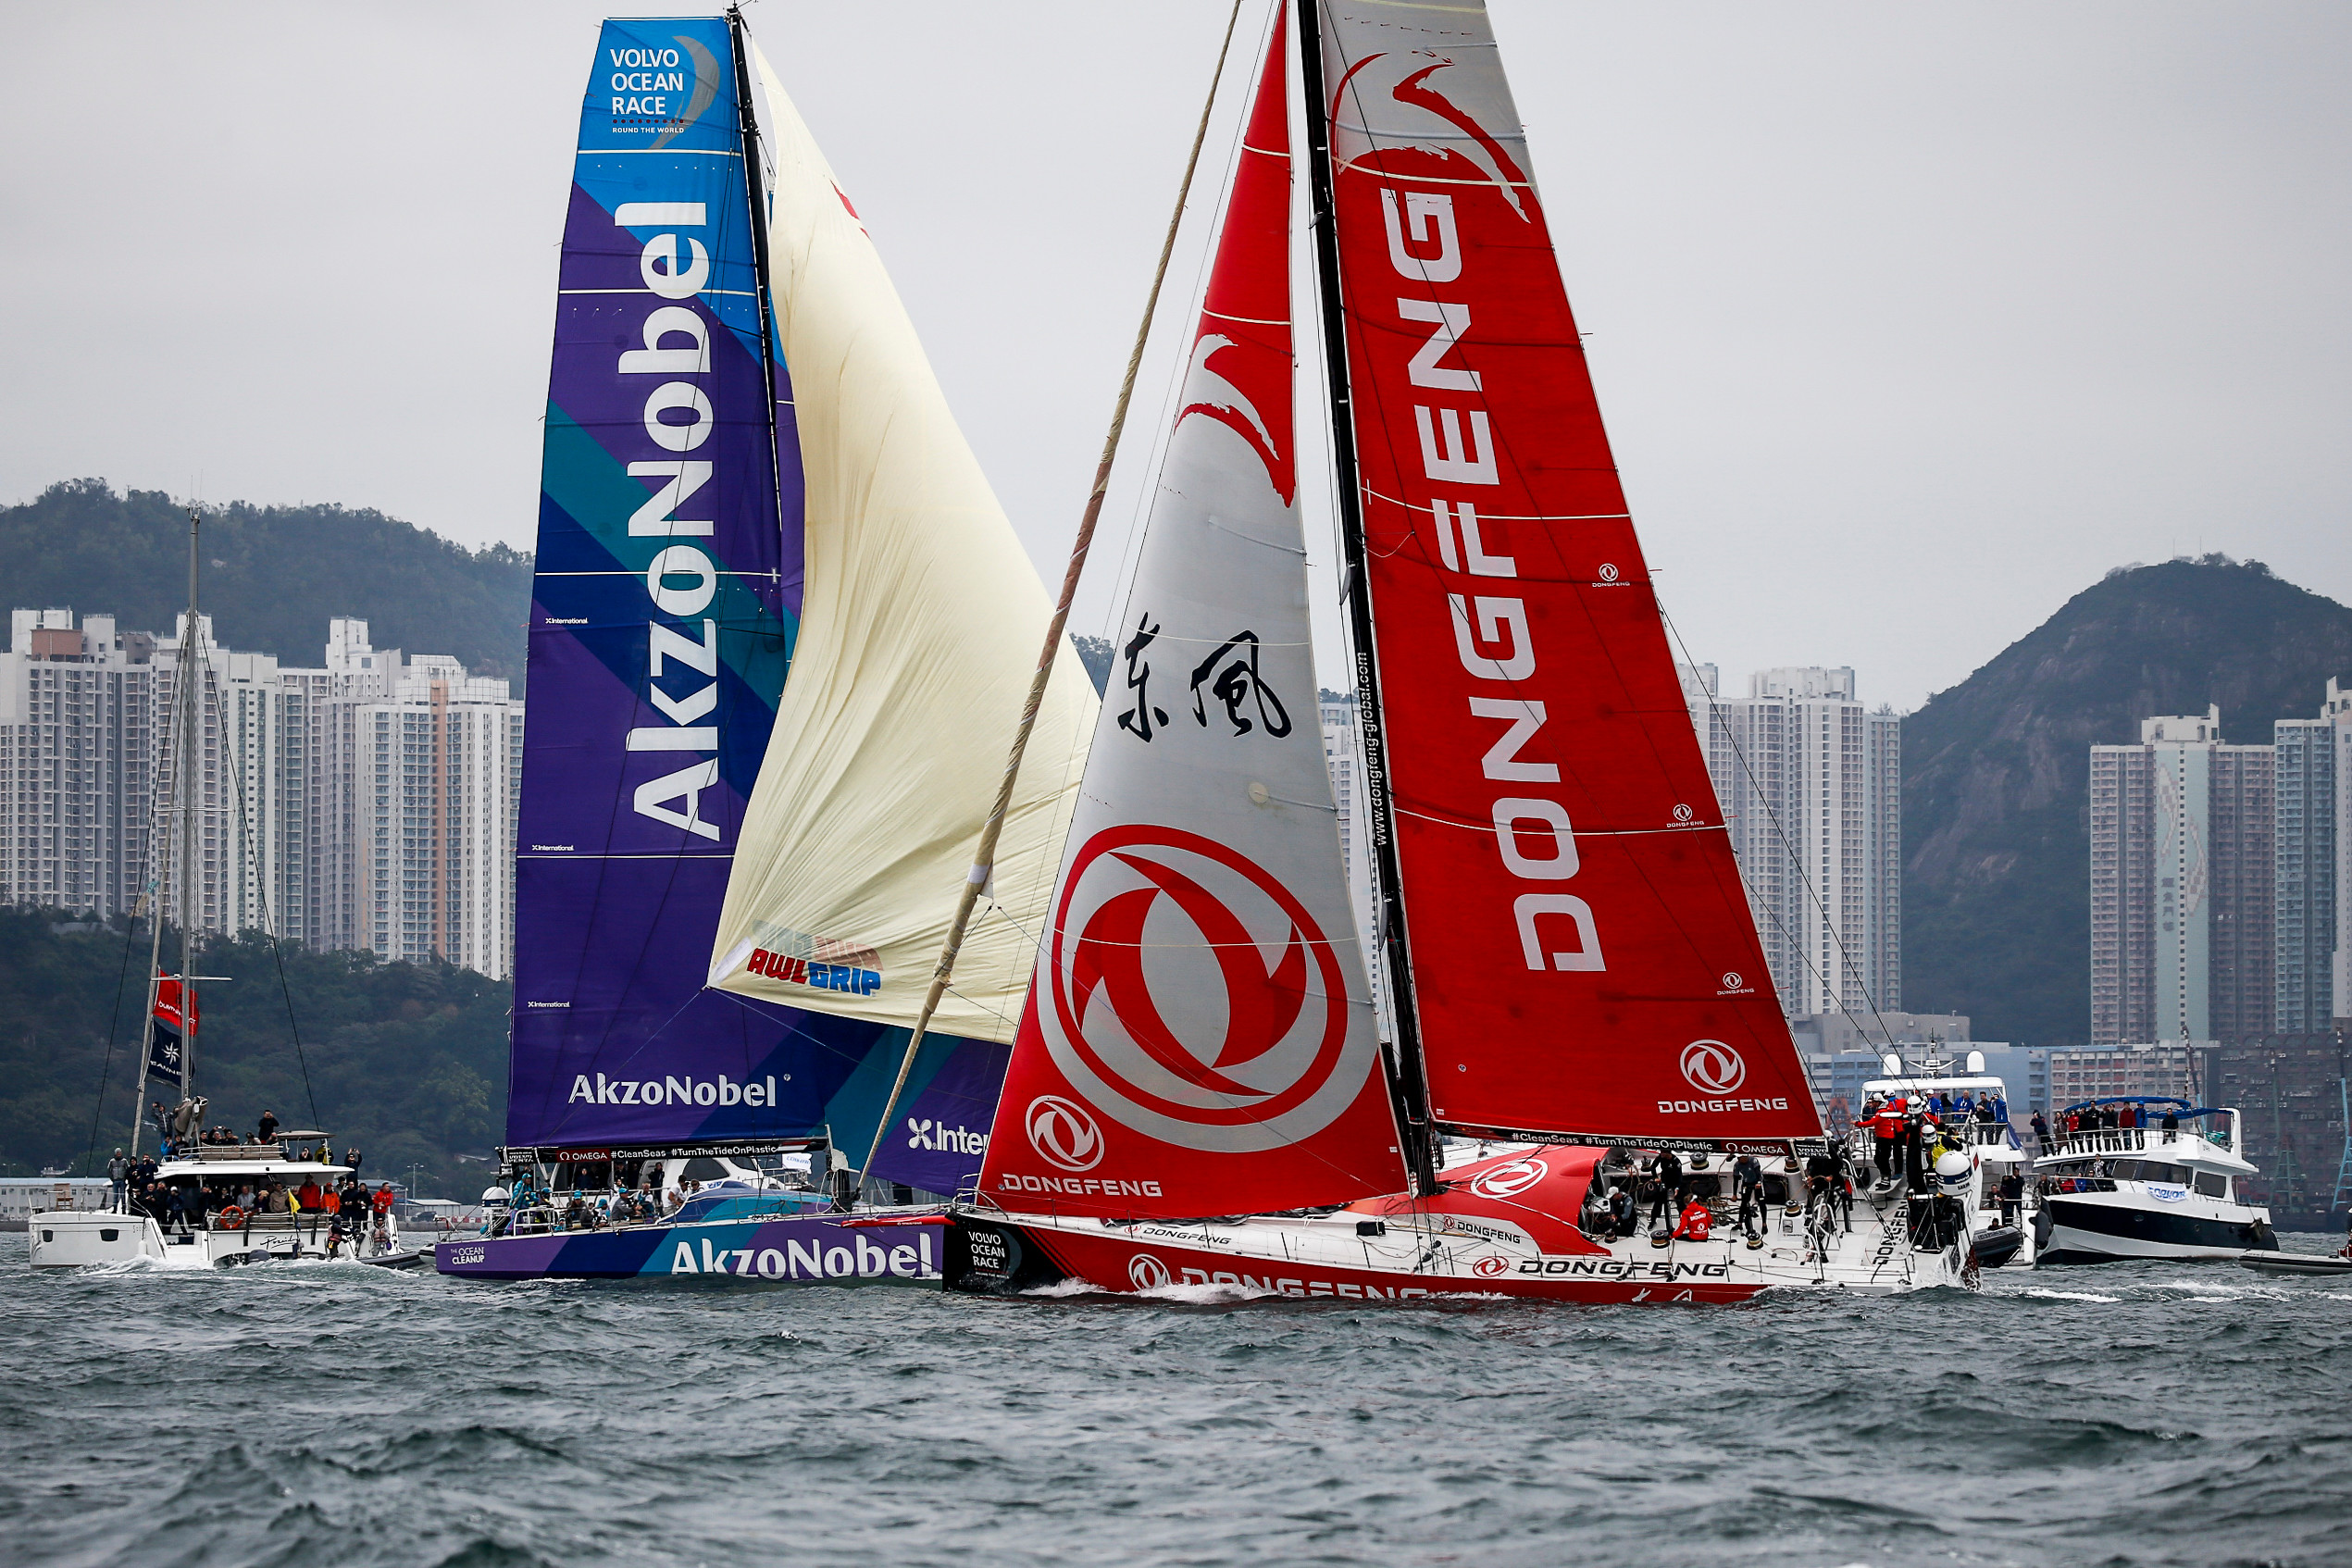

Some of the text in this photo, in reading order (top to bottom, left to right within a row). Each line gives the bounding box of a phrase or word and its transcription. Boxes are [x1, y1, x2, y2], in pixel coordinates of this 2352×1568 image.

[610, 48, 679, 68] VOLVO
[611, 72, 684, 91] OCEAN
[612, 96, 666, 115] RACE
[614, 202, 720, 842] AkzoNobel
[1379, 187, 1607, 972] DONGFENG
[1357, 651, 1388, 847] www.dongfeng-global.com
[746, 947, 881, 996] AWLGRIP
[567, 1072, 777, 1107] AkzoNobel
[1657, 1098, 1788, 1114] DONGFENG
[1512, 1132, 1713, 1151] #CleanSeas #TurnTheTideOnPlastic
[1741, 1144, 1786, 1155] OMEGA
[571, 1145, 778, 1161] OMEGA #CleanSeas #TurnTheTideOnPlastic
[1002, 1173, 1163, 1198] DONGFENG
[968, 1231, 1001, 1245] VOLVO
[1142, 1226, 1232, 1245] DONGFENG
[1457, 1221, 1521, 1244] DONGFENG
[452, 1255, 485, 1264] CLEANUP
[458, 1247, 484, 1256] OCEAN
[671, 1232, 933, 1280] AkzoNobel
[971, 1244, 1005, 1258] OCEAN
[973, 1256, 999, 1269] RACE
[1518, 1260, 1727, 1277] DONGFENG
